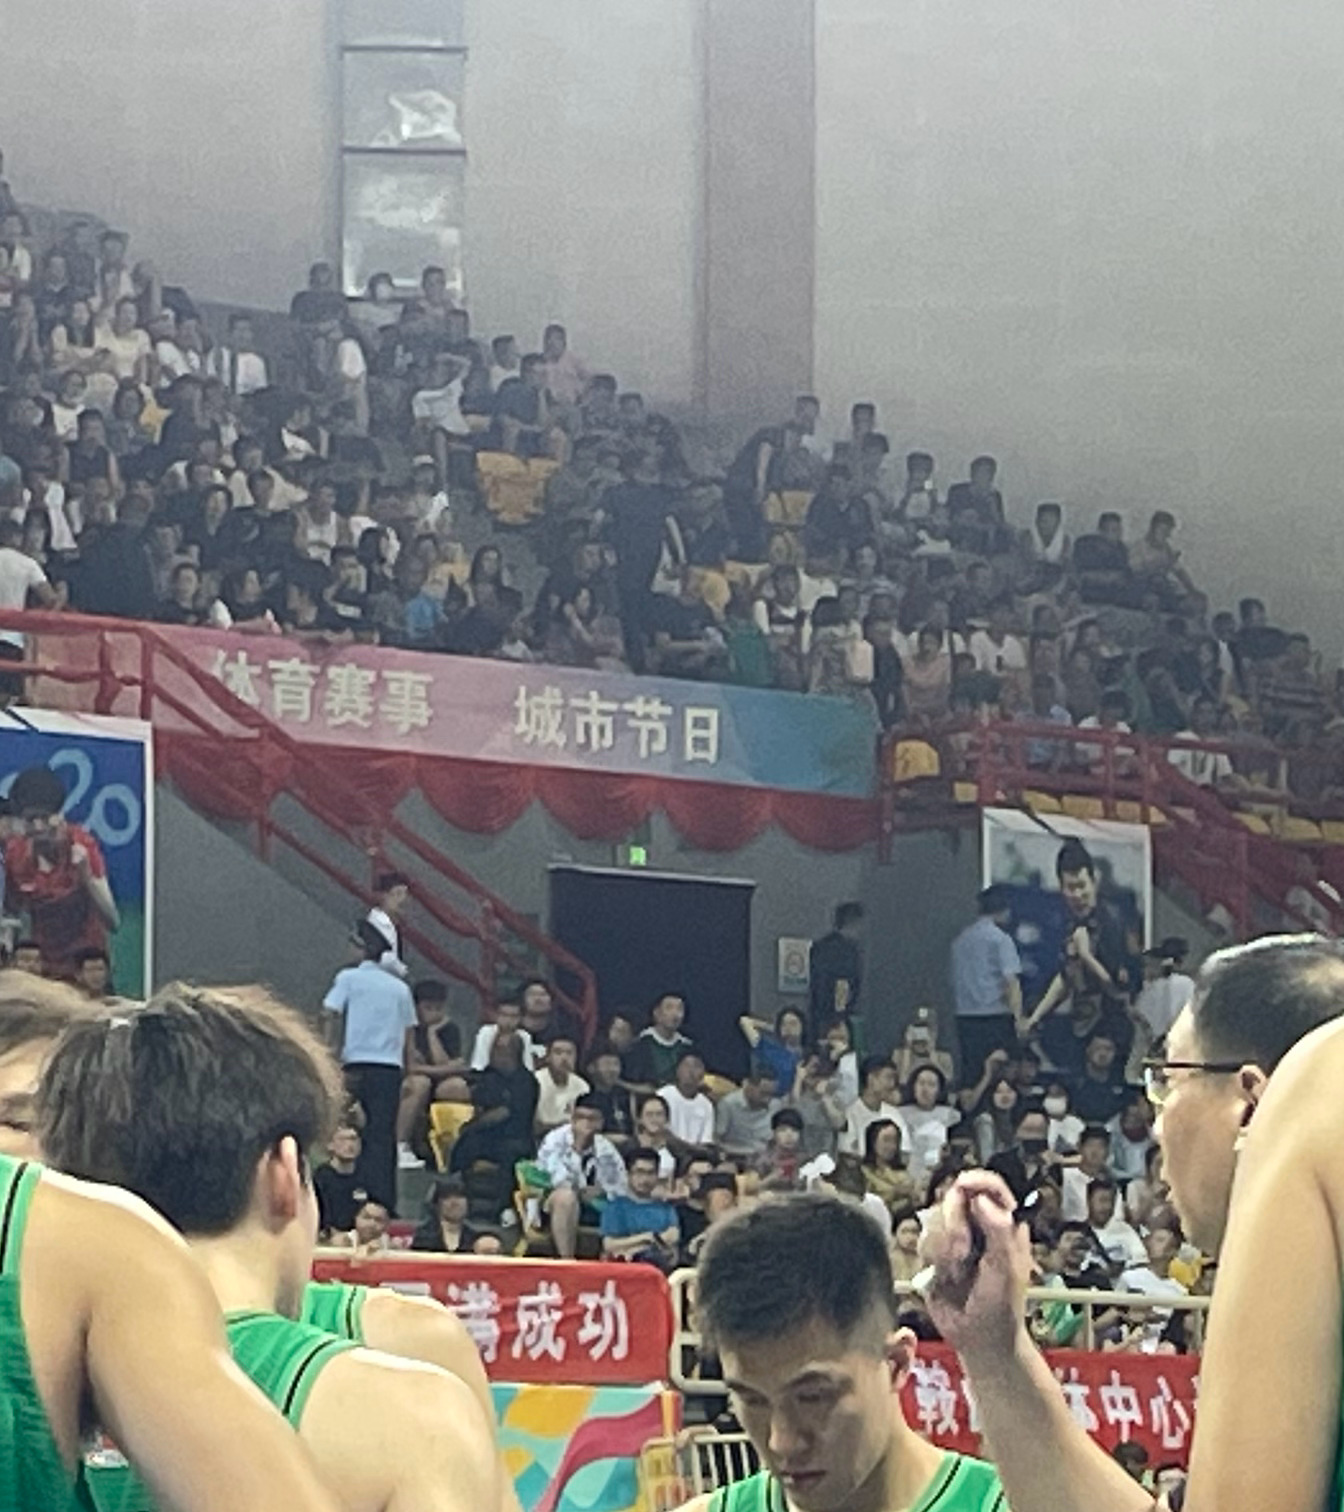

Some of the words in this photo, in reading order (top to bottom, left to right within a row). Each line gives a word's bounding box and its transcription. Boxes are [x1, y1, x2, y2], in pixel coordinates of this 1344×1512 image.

[213, 650, 434, 735] 体育赛事
[514, 686, 721, 765] 城市节日
[379, 1280, 628, 1362] 满成功
